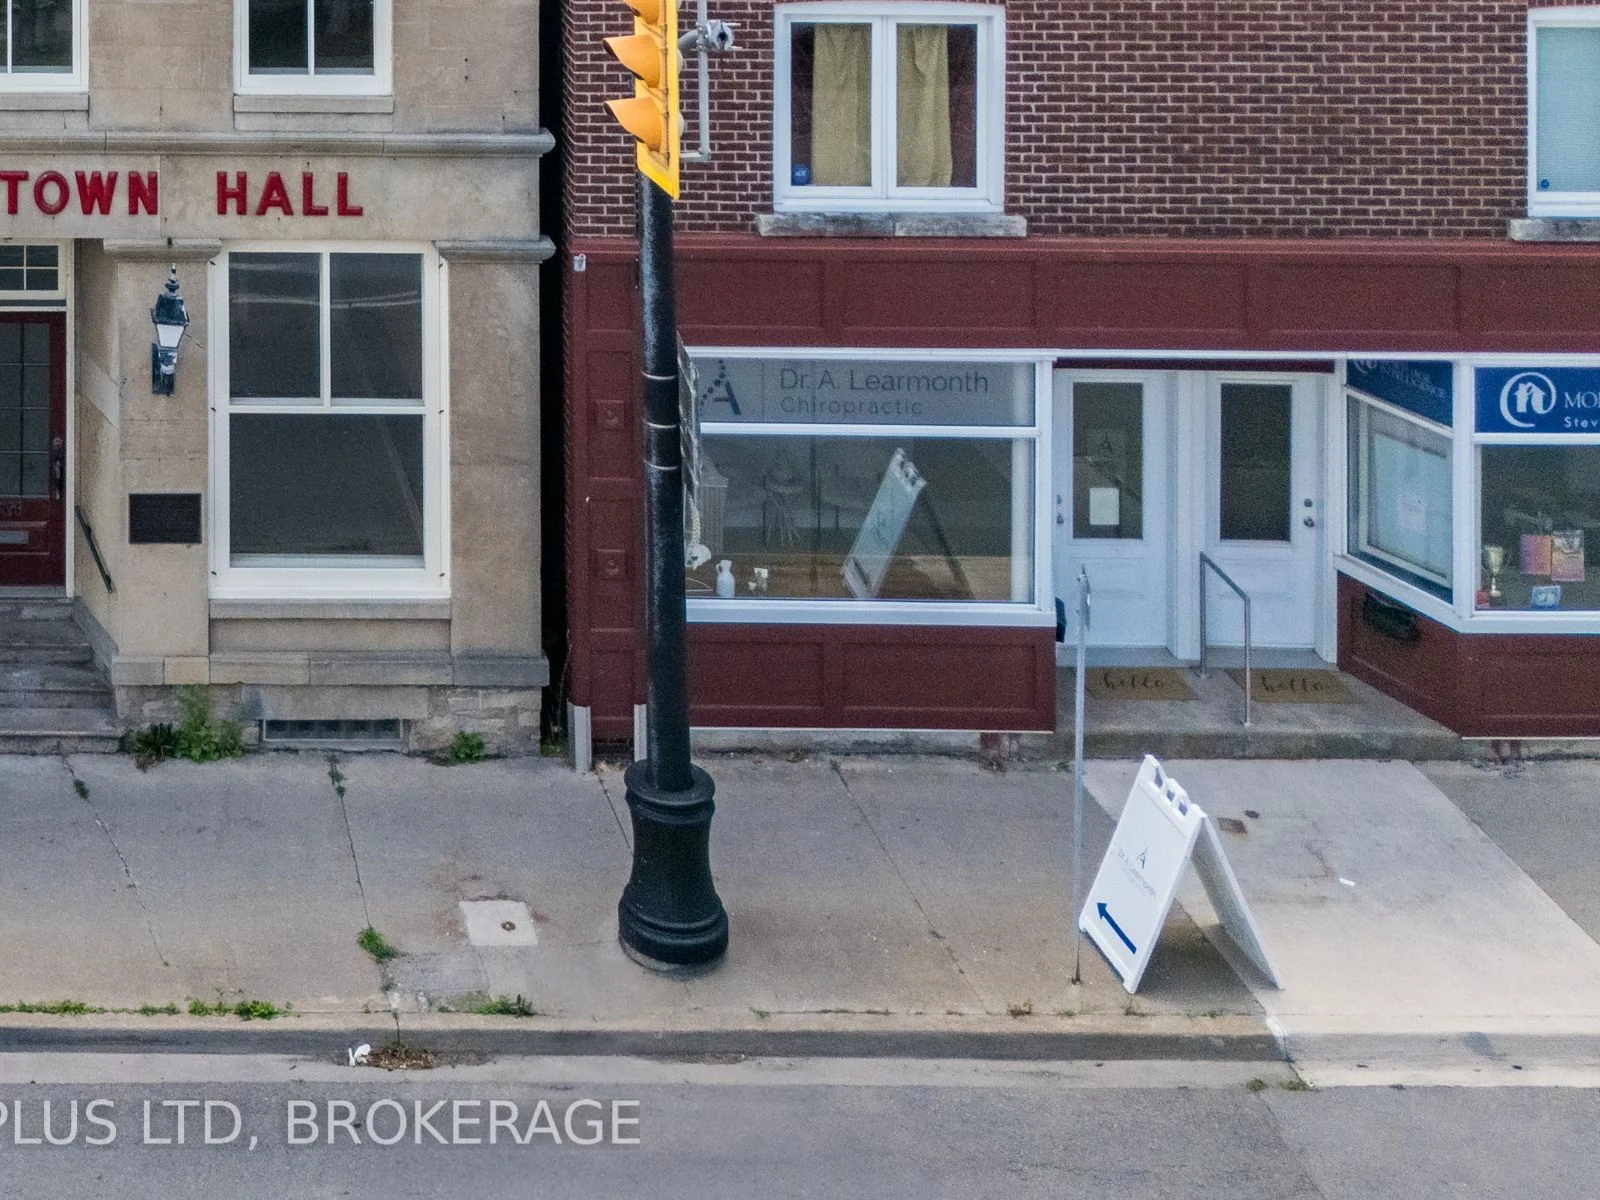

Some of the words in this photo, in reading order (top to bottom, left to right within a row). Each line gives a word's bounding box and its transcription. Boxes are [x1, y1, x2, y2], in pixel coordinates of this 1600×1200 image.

[216, 171, 363, 217] HALL
[779, 367, 811, 391] Dr.
[817, 369, 841, 391] A.
[850, 370, 989, 394] Learmonth
[780, 396, 923, 418] Chiropractic
[1564, 391, 1600, 409] MO
